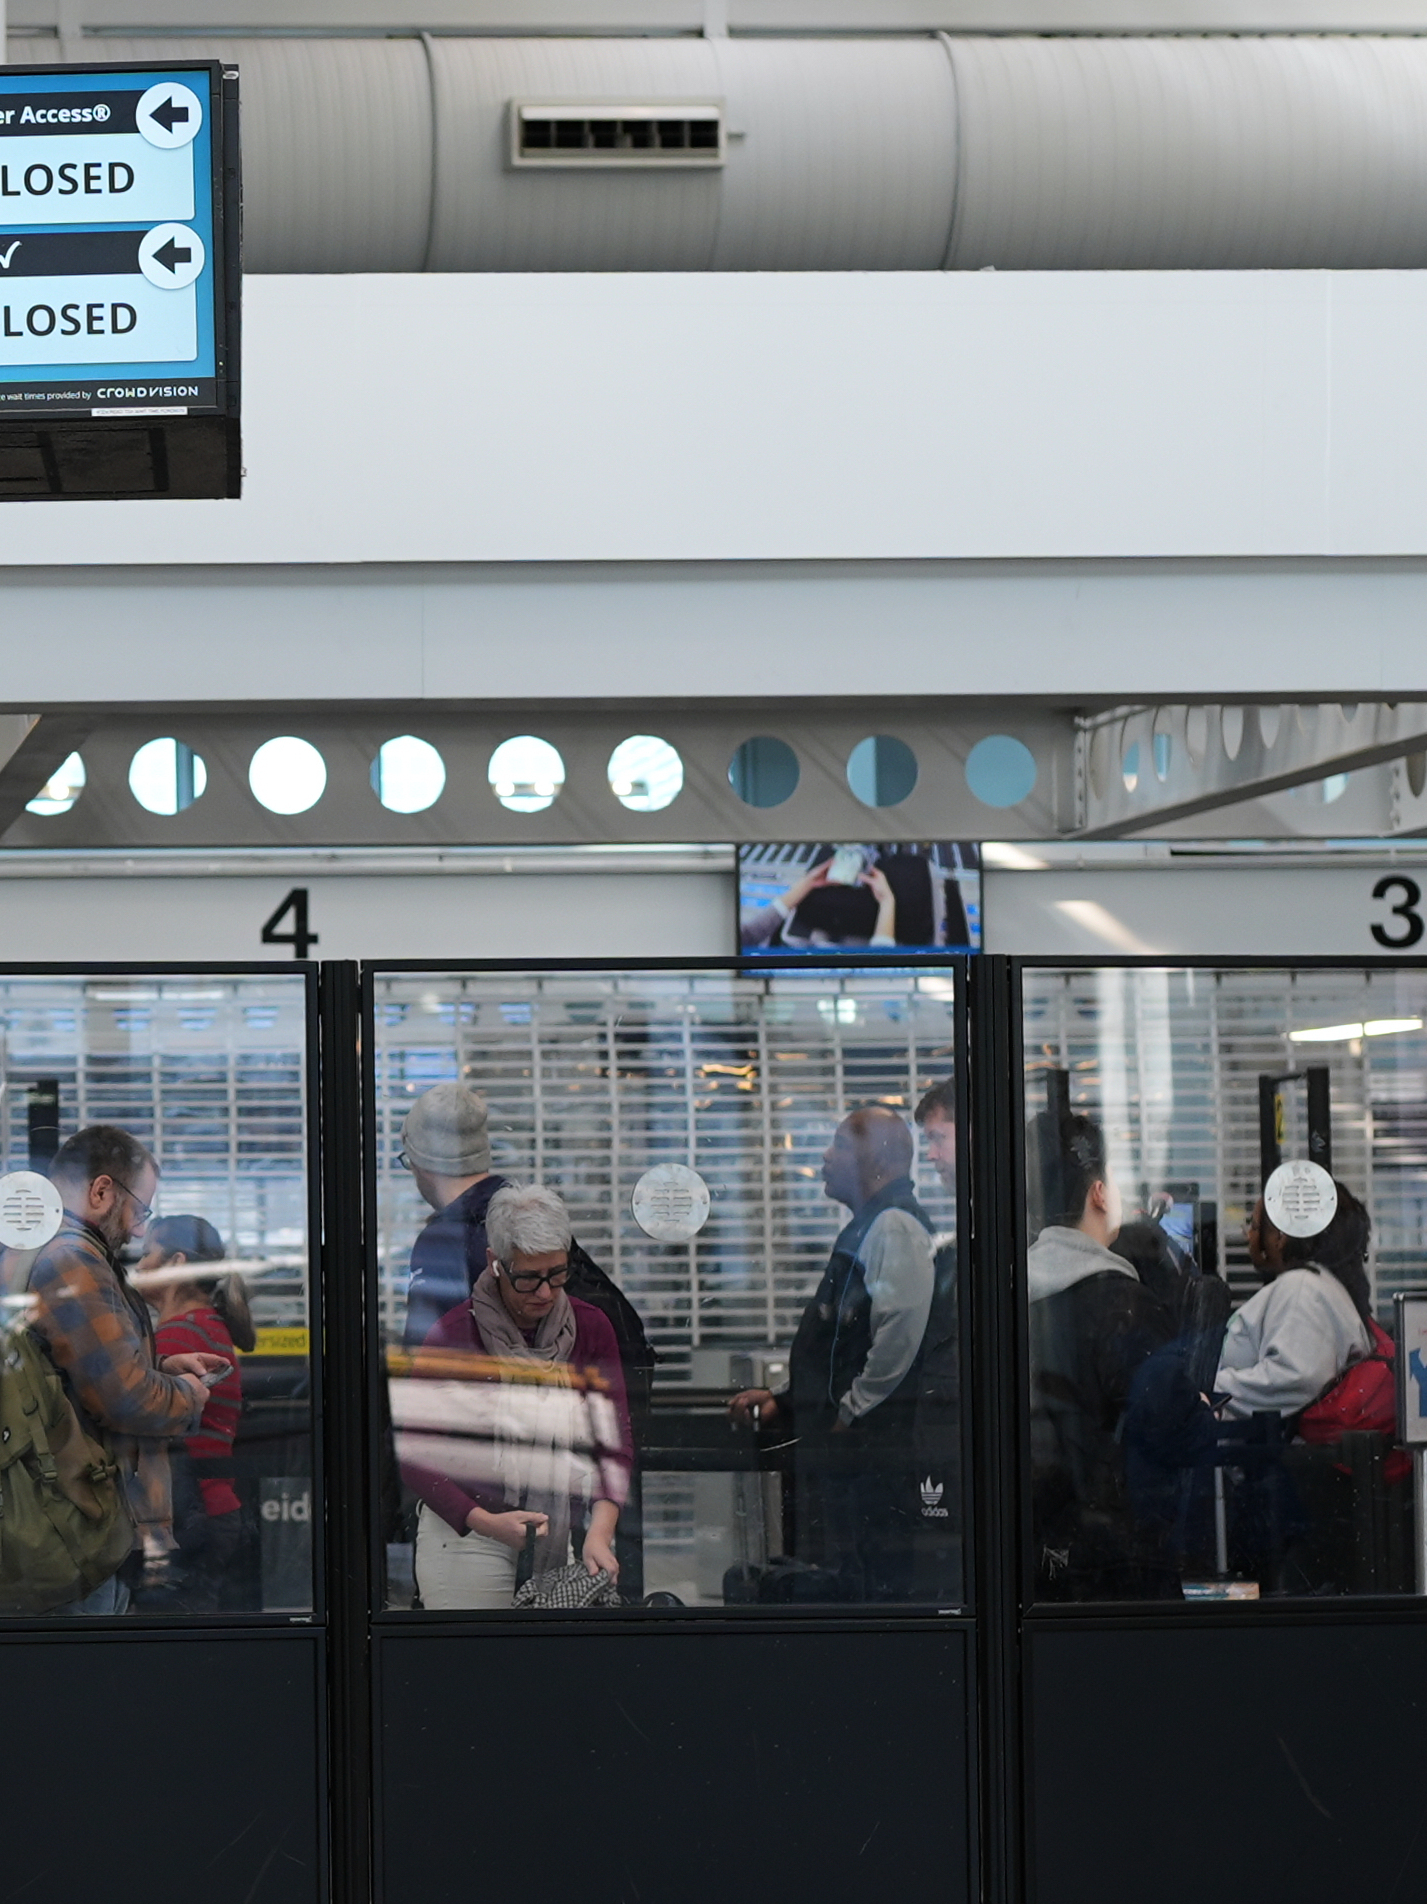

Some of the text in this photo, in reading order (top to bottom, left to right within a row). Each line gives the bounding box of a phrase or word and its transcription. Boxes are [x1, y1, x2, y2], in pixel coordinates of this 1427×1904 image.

[6, 392, 23, 401] wait
[24, 392, 46, 401] times
[46, 391, 80, 402] provided
[80, 391, 92, 401] by
[260, 888, 318, 959] 4
[1369, 875, 1425, 949] 3
